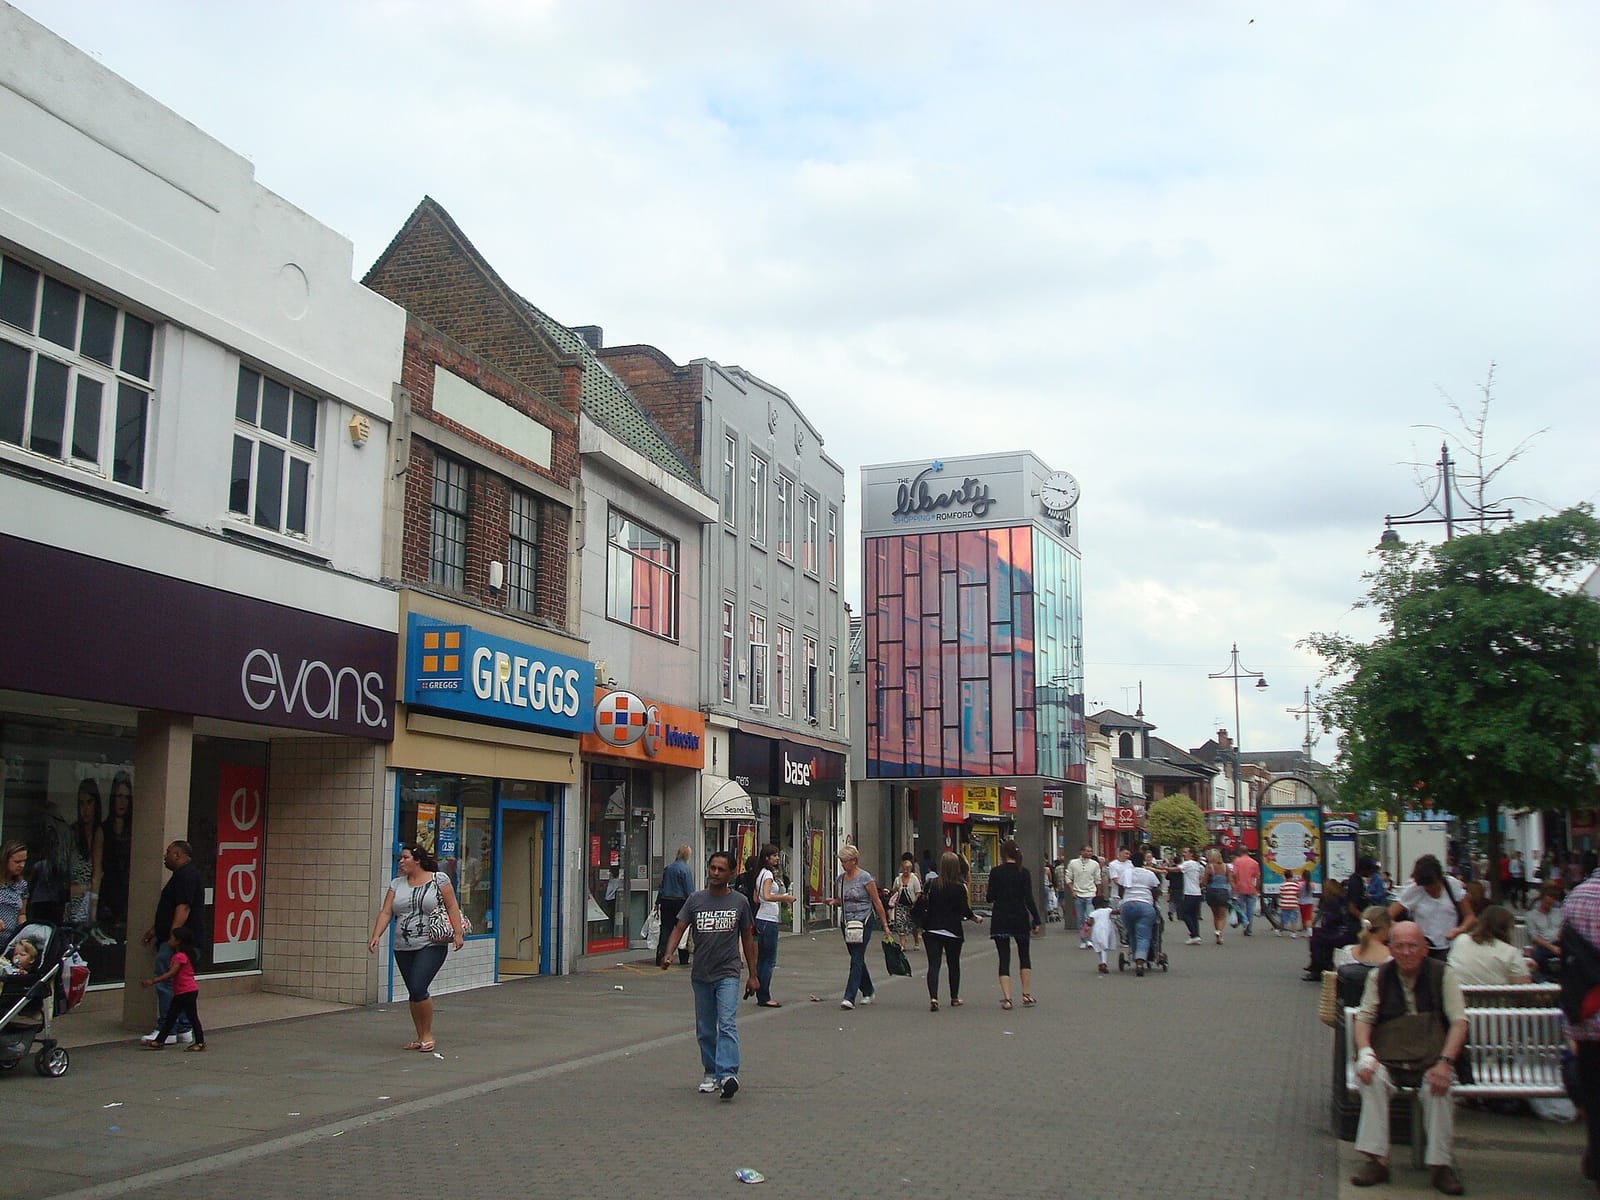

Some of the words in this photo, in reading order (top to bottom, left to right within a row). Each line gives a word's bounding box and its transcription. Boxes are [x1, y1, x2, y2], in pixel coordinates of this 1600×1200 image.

[893, 513, 932, 525] SHOPPING
[936, 511, 973, 521] ROMFORD
[429, 681, 458, 689] GREGGS
[472, 646, 580, 717] GREGGS
[784, 751, 810, 787] base
[218, 786, 261, 944] sale
[696, 910, 737, 919] ATHLETICS
[696, 918, 715, 930] 82
